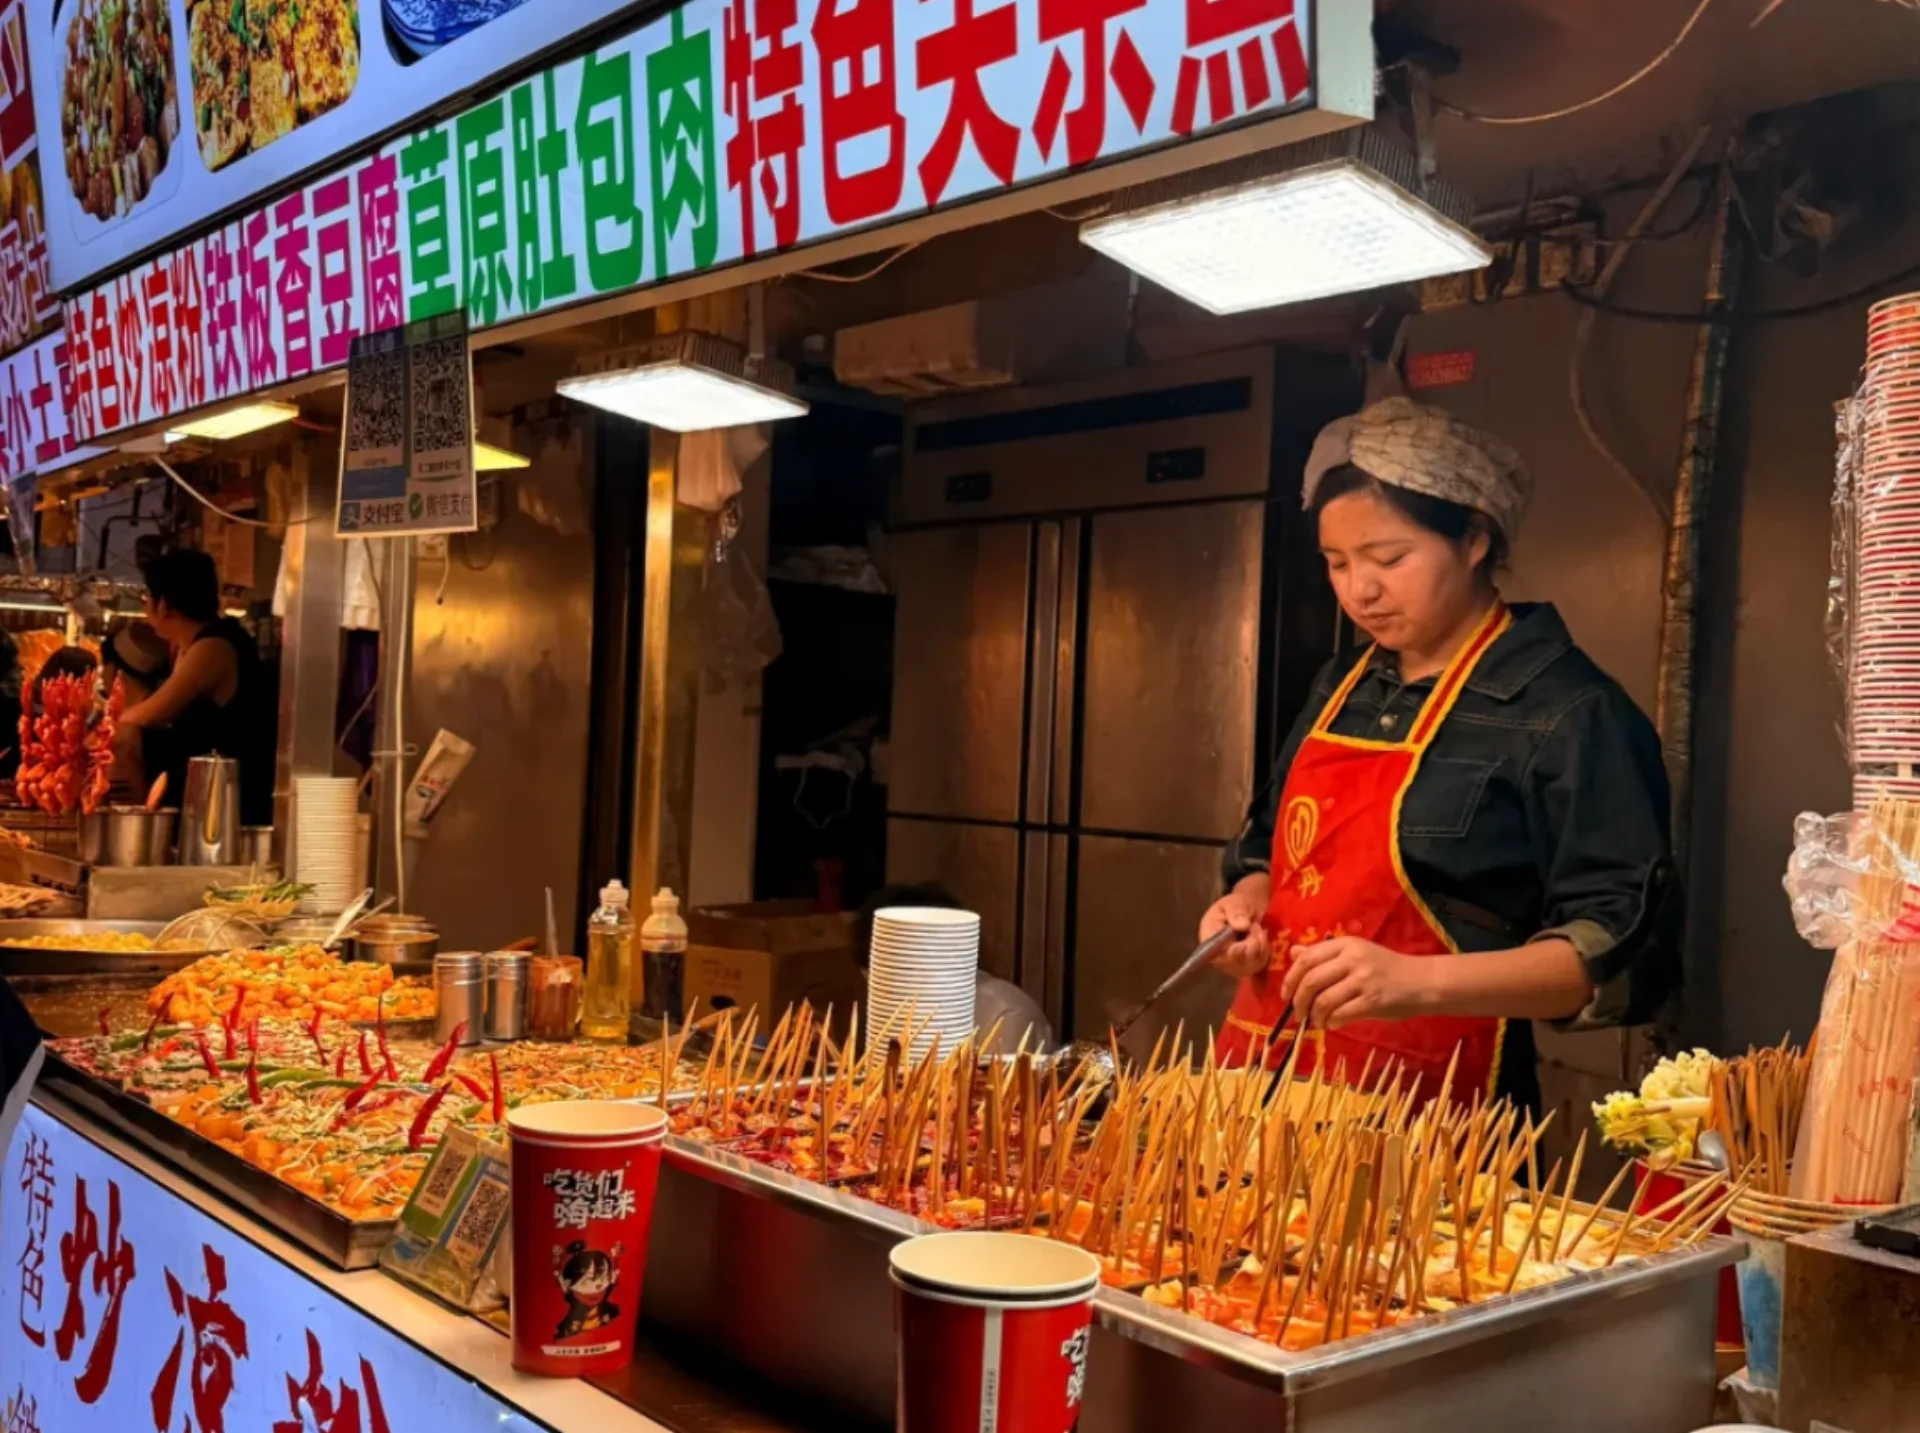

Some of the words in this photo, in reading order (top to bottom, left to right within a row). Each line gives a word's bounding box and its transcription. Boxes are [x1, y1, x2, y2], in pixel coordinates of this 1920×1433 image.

[203, 152, 405, 397] 铁板香豆腐
[400, 9, 719, 327] 草原肚包肉
[363, 502, 404, 525] 支付宝
[17, 1132, 57, 1349] 特色
[543, 1168, 624, 1198] 吃货们
